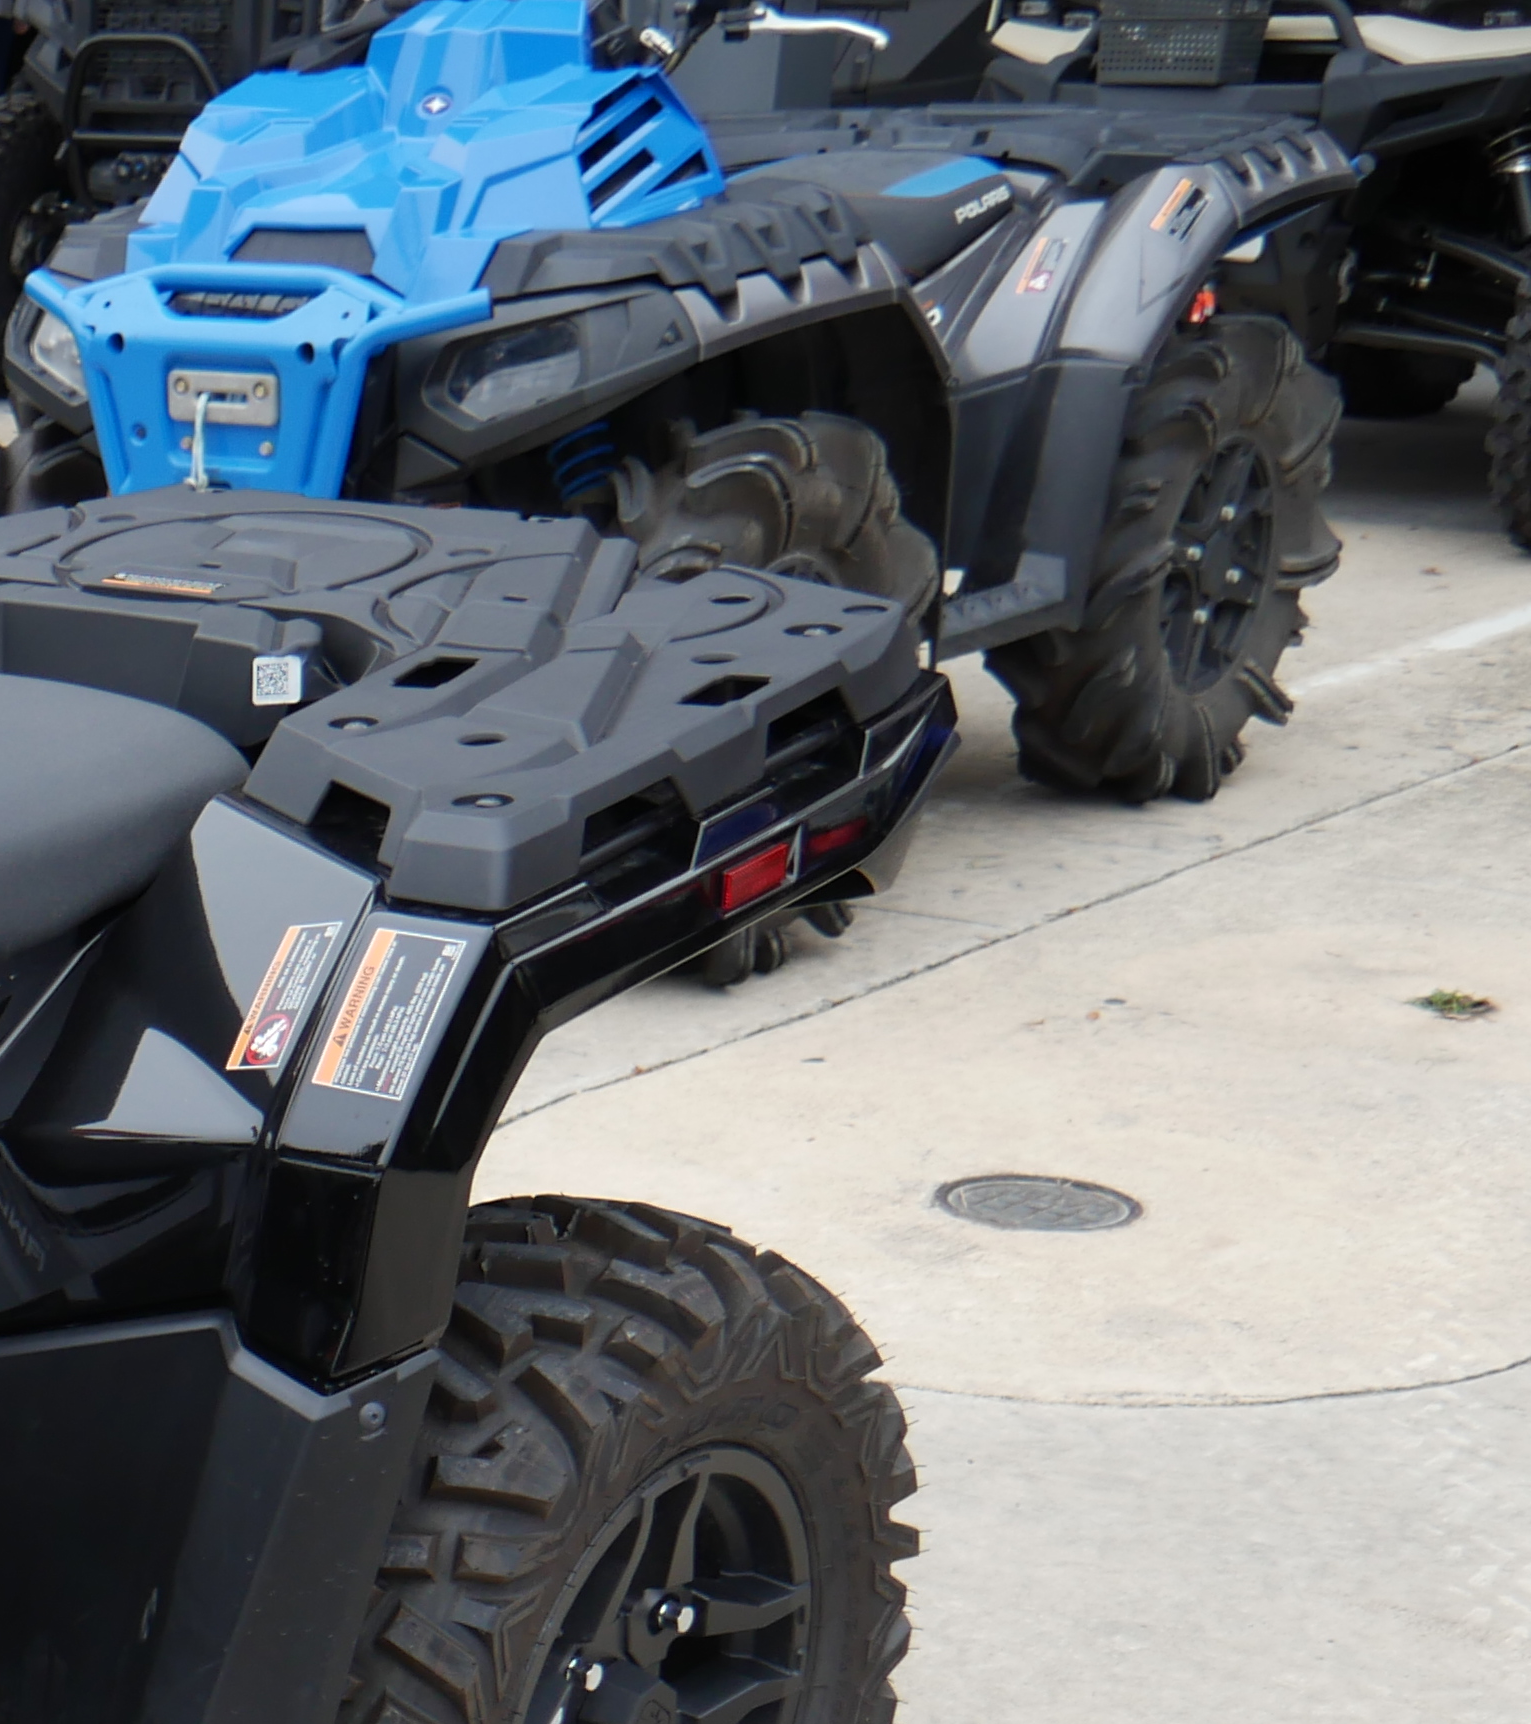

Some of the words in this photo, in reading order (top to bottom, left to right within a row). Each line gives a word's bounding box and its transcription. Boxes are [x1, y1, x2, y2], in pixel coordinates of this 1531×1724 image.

[953, 184, 1011, 225] POLARIS
[247, 961, 282, 1023] WARNING
[339, 965, 375, 1030] WARNING
